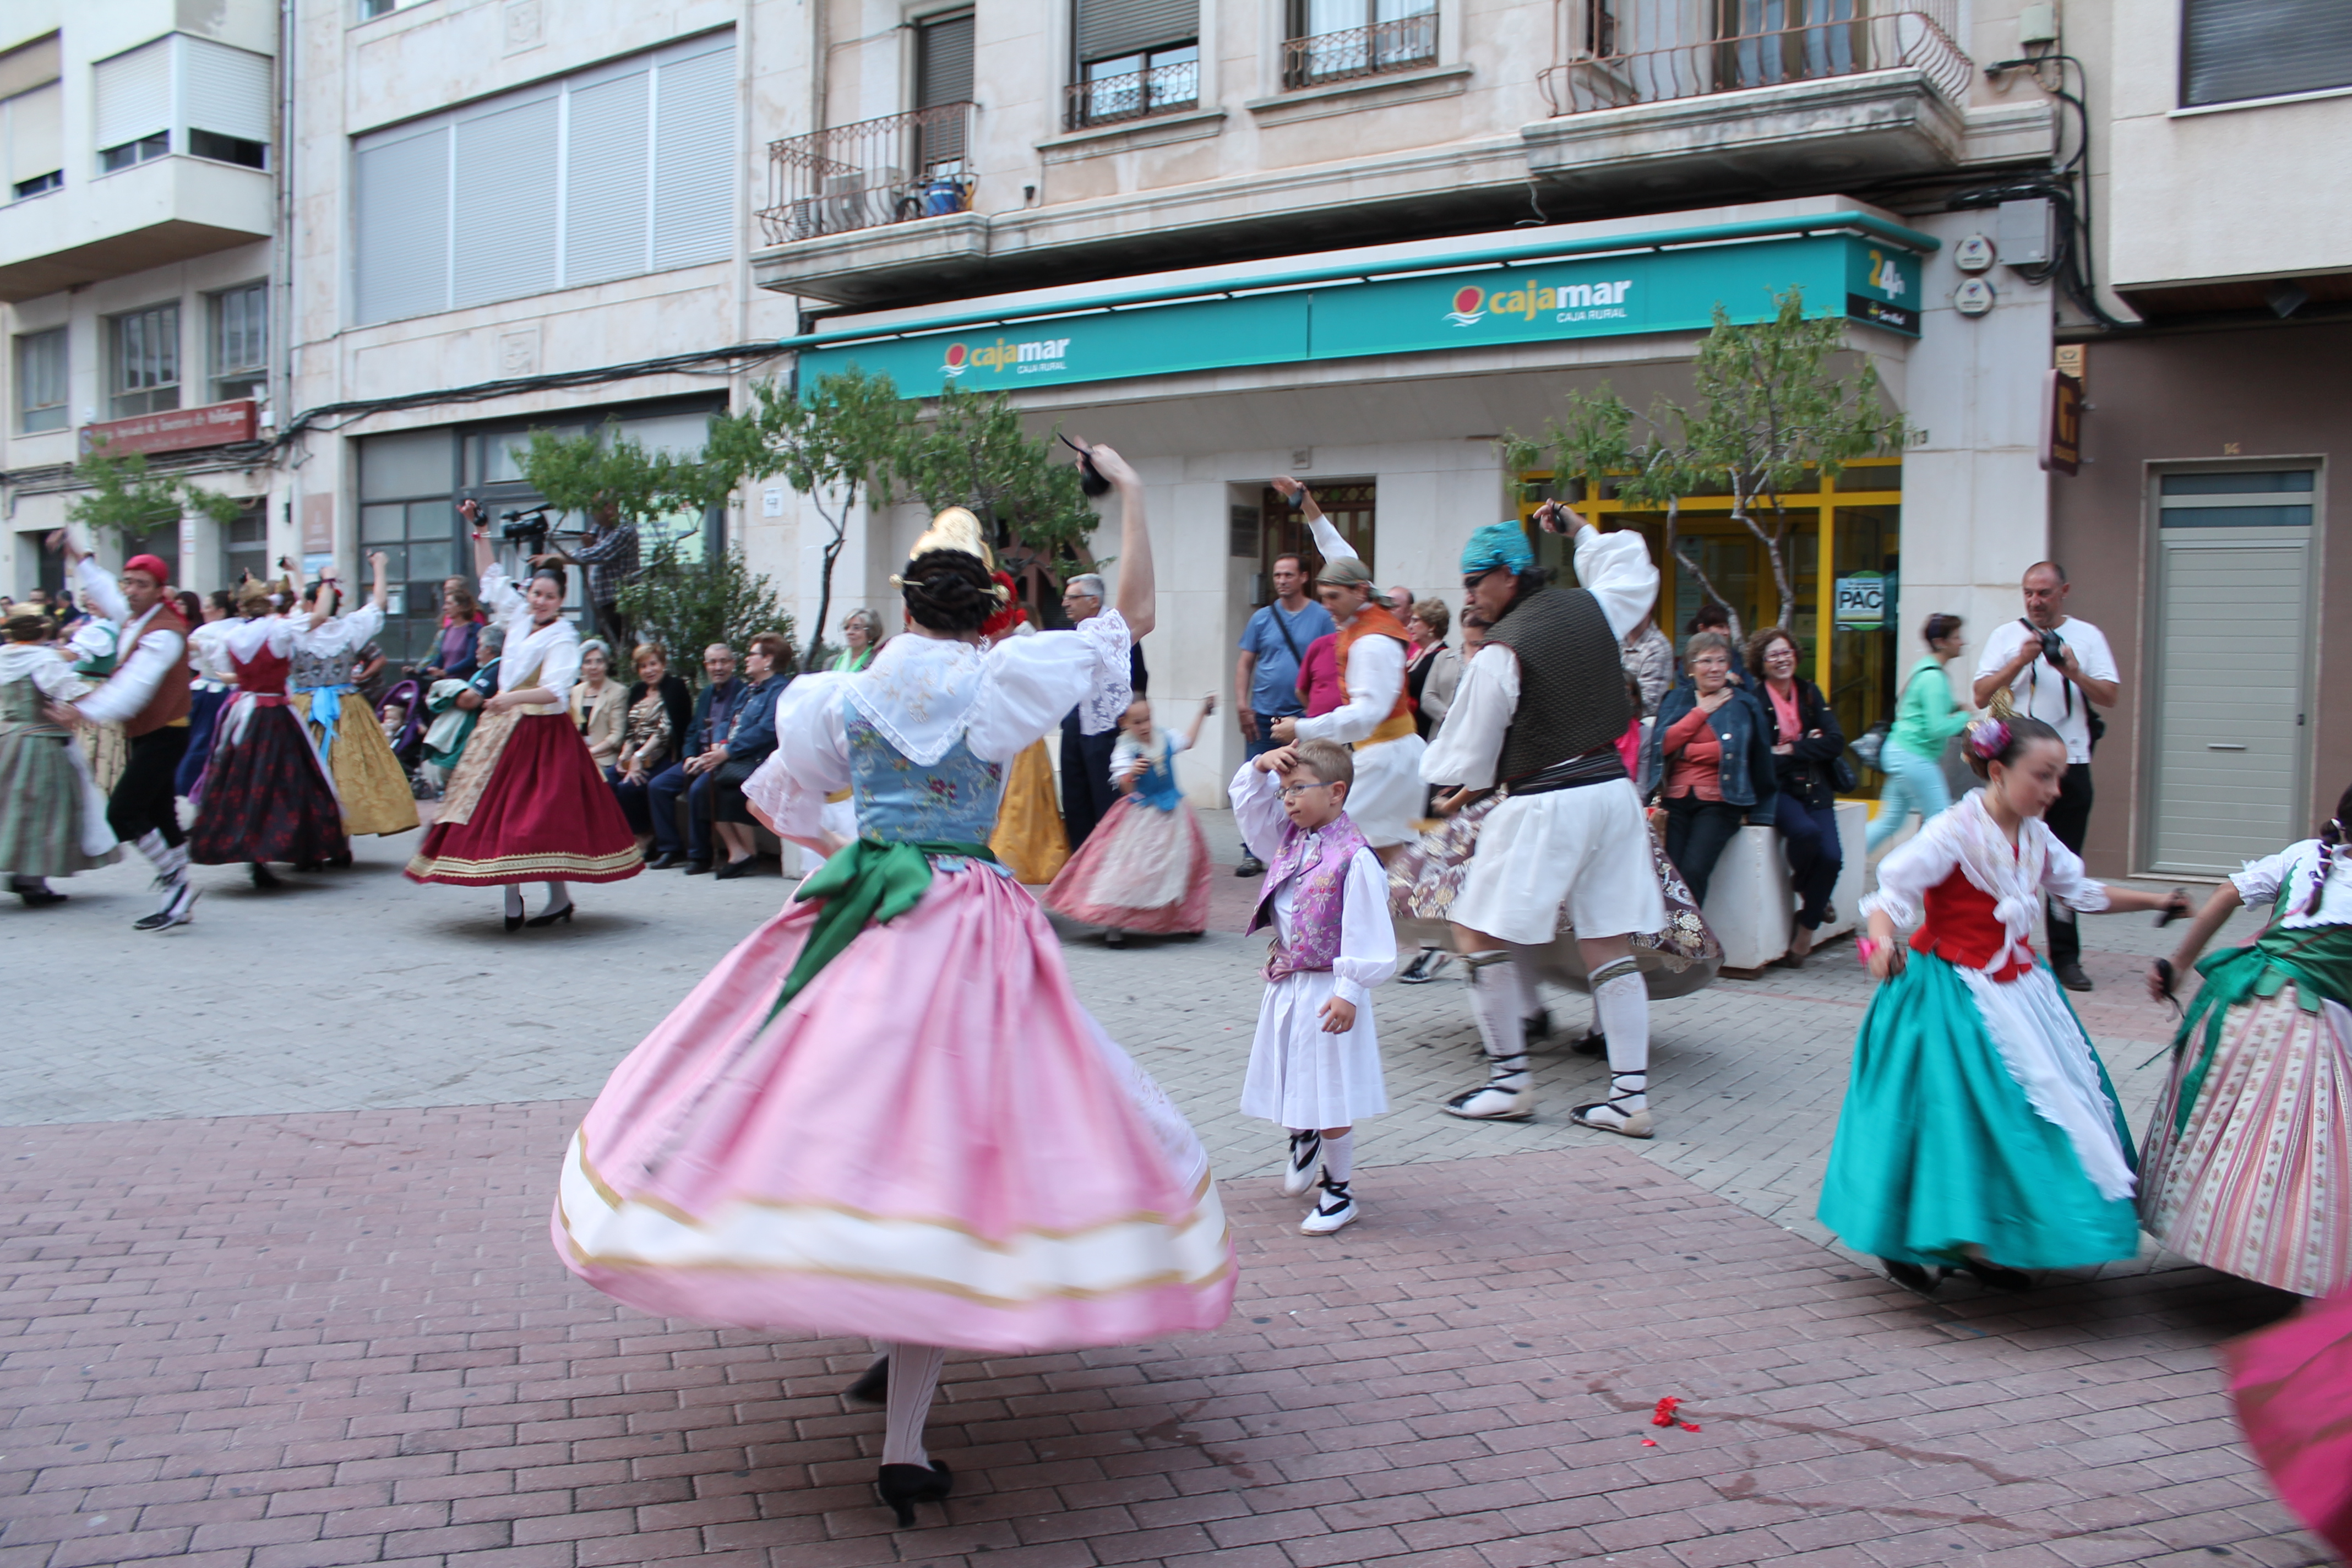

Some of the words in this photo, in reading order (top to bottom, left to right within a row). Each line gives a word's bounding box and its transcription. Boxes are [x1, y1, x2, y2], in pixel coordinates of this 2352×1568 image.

[1488, 280, 1632, 321] cajamar
[1556, 312, 1587, 323] CAJA
[1588, 308, 1627, 319] RURAL
[970, 337, 1071, 373] cajamar
[1017, 364, 1039, 374] CAJA
[1040, 361, 1068, 372] RURAL
[1839, 590, 1883, 609] PAC
